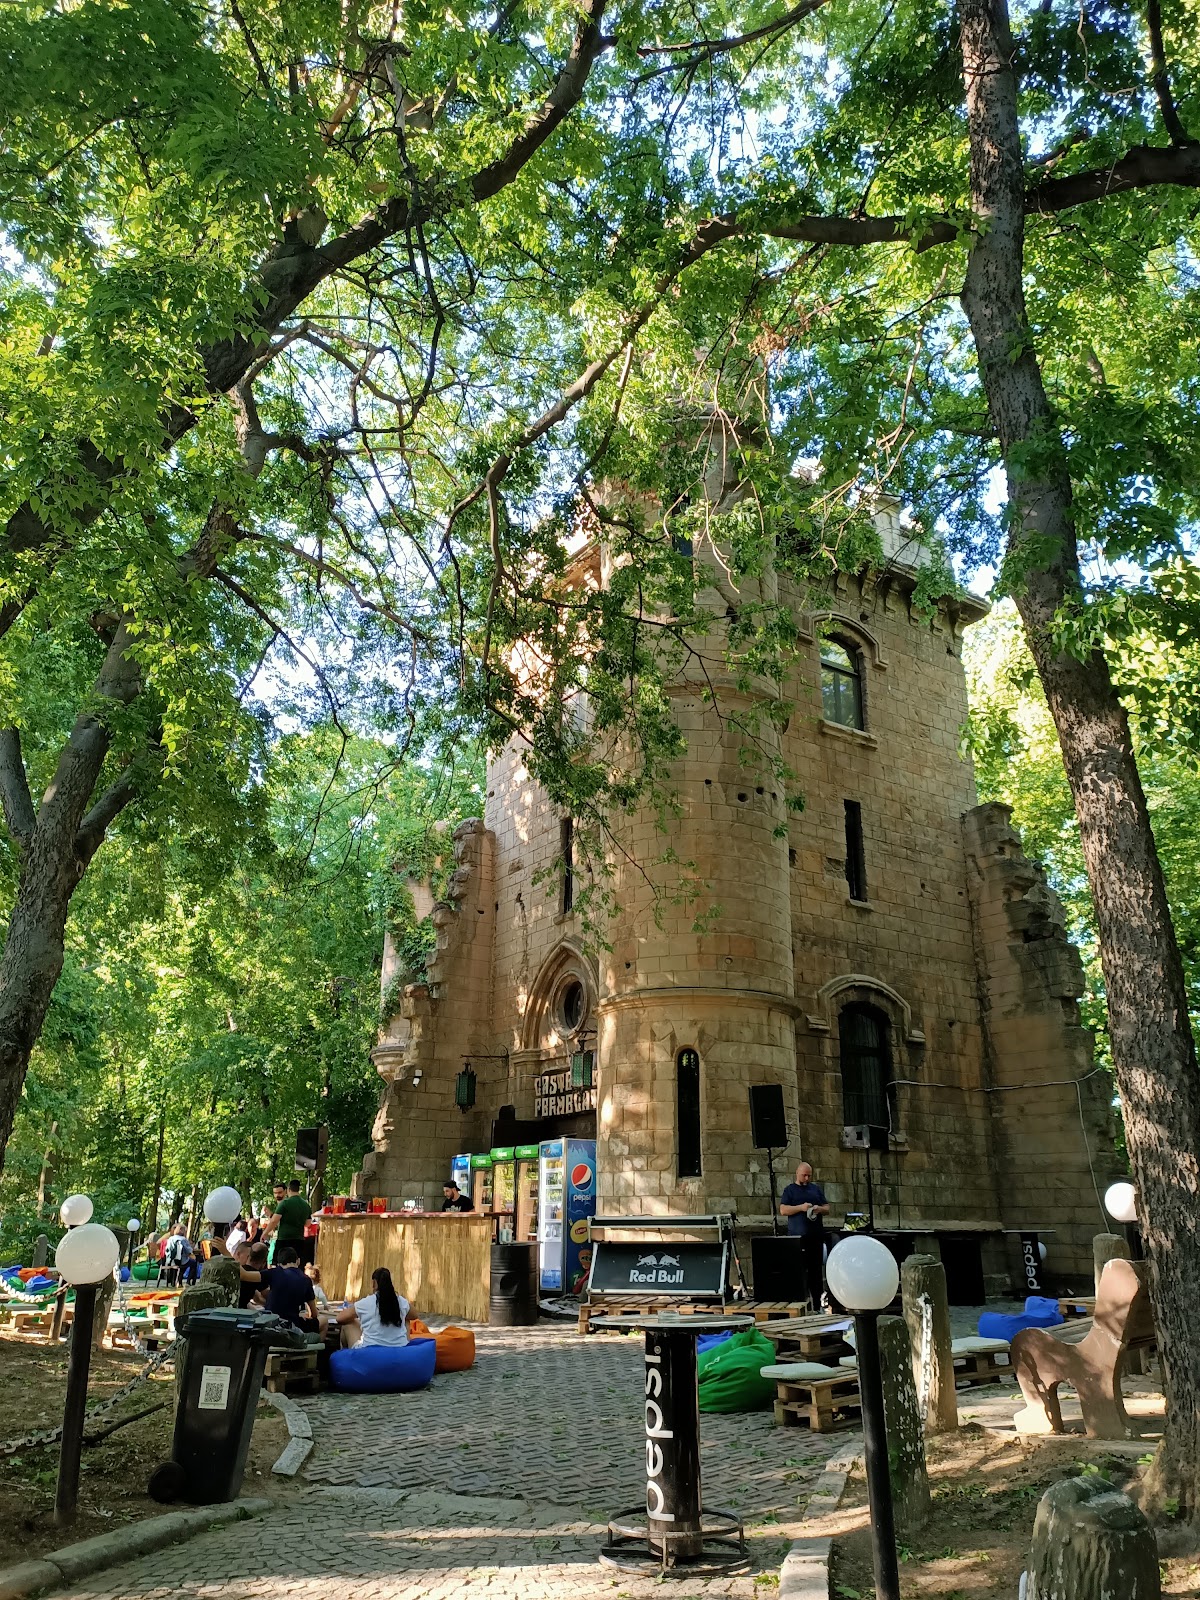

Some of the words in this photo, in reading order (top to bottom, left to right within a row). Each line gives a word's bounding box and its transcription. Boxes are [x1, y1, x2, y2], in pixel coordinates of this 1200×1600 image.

[573, 1193, 591, 1202] pepsi
[629, 1269, 656, 1283] Red
[657, 1269, 684, 1283] Bull
[1022, 1241, 1041, 1289] pepsi
[645, 1354, 675, 1522] pepsi
